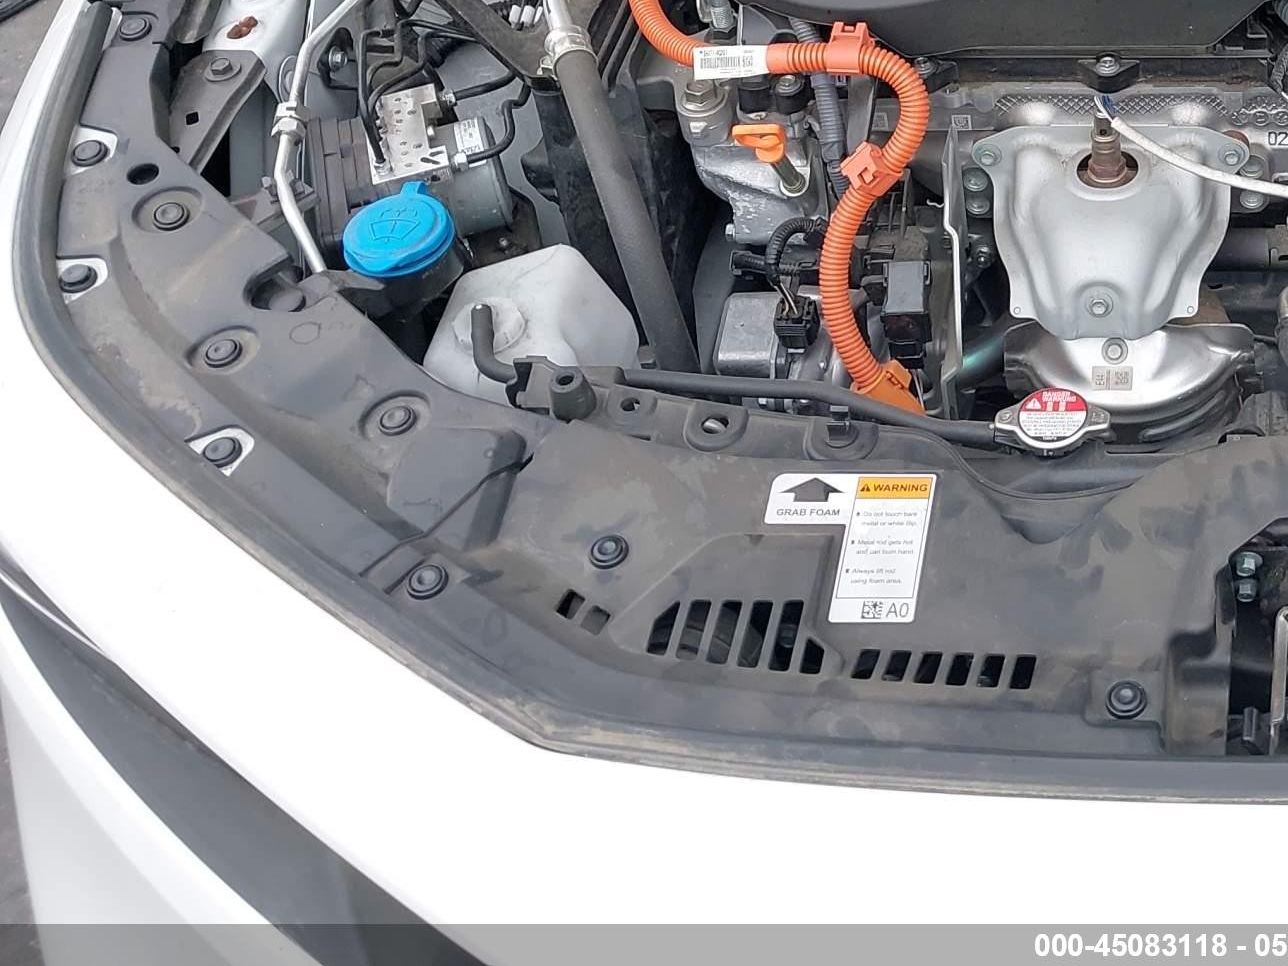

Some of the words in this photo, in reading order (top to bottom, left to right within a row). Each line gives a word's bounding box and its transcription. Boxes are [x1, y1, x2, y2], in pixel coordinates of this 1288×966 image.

[873, 483, 928, 493] WARNING
[776, 508, 806, 516] GRAB
[809, 508, 840, 516] FOAM
[885, 602, 910, 618] A0
